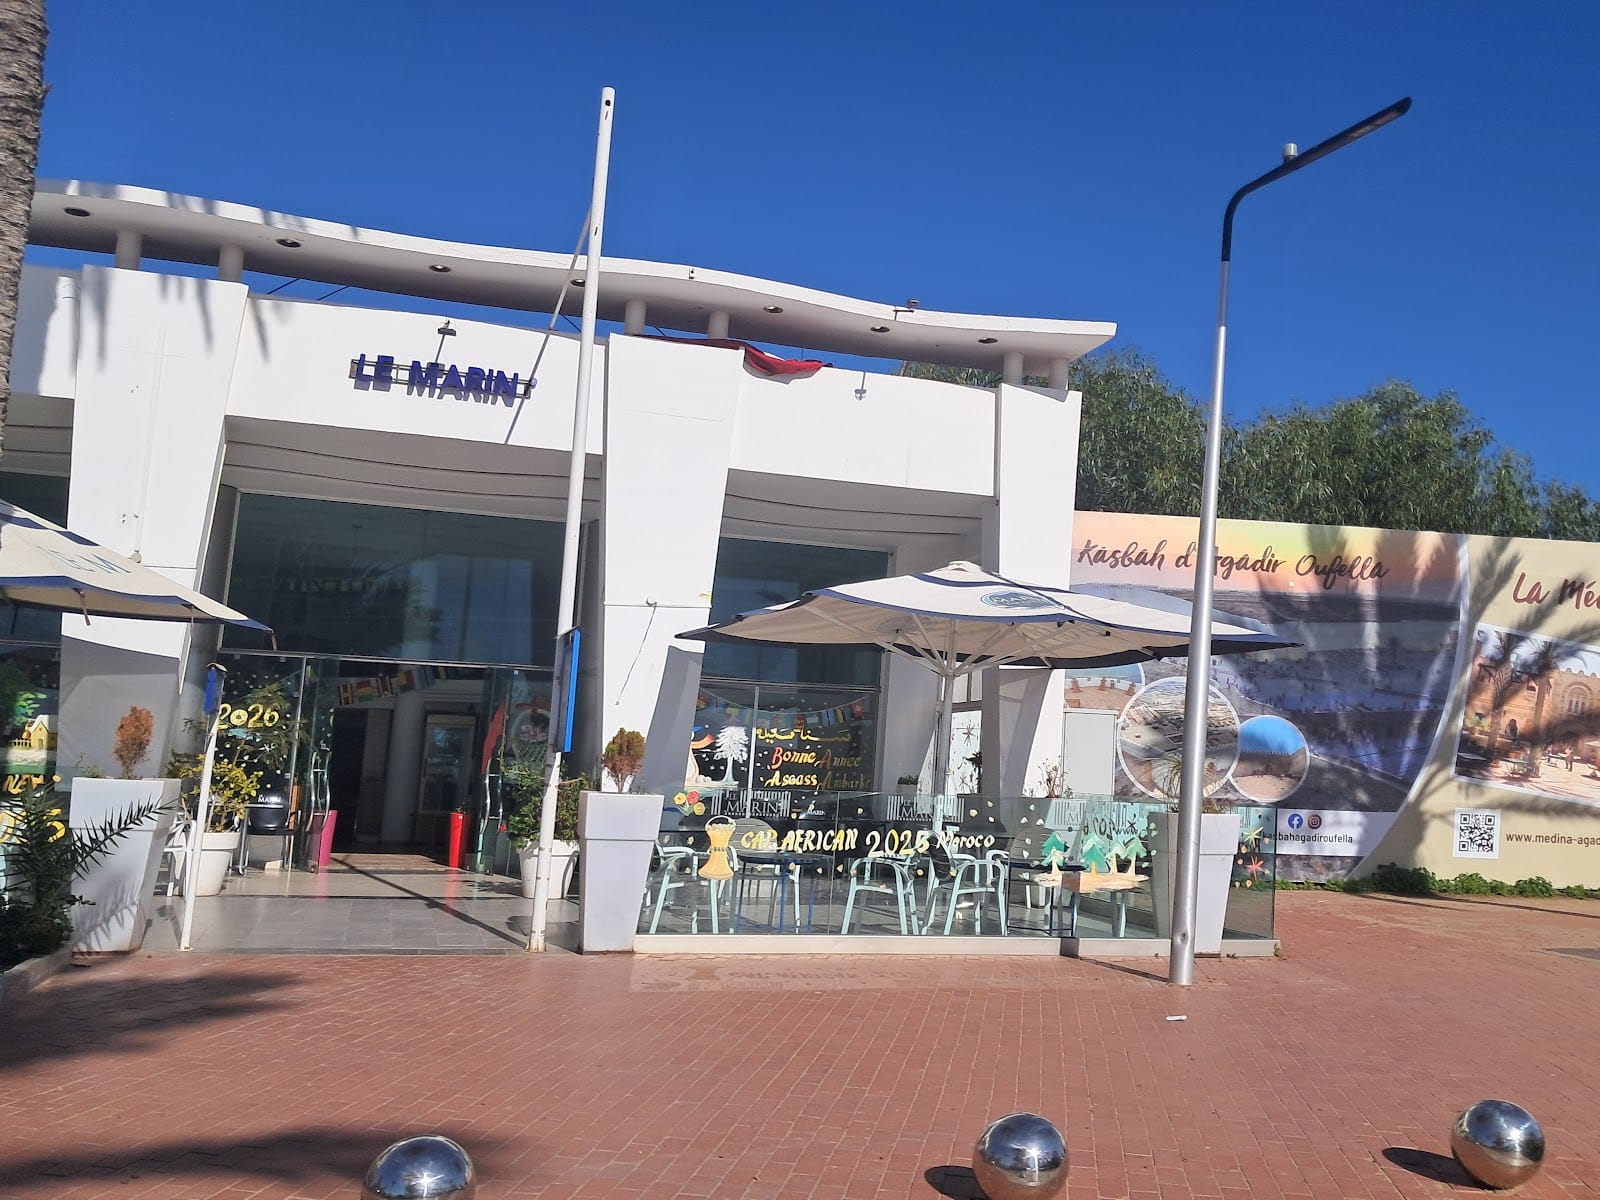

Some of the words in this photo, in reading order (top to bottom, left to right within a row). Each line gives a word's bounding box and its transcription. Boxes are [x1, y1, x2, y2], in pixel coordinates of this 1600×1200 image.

[355, 353, 395, 384] LE
[410, 360, 519, 399] MARIN
[1077, 540, 1168, 572] Kasbah
[1295, 554, 1389, 590] Oufella
[1512, 571, 1551, 605] La
[1557, 578, 1600, 610] Mé
[771, 746, 818, 770] Bonne
[781, 828, 859, 852] AFRICAN
